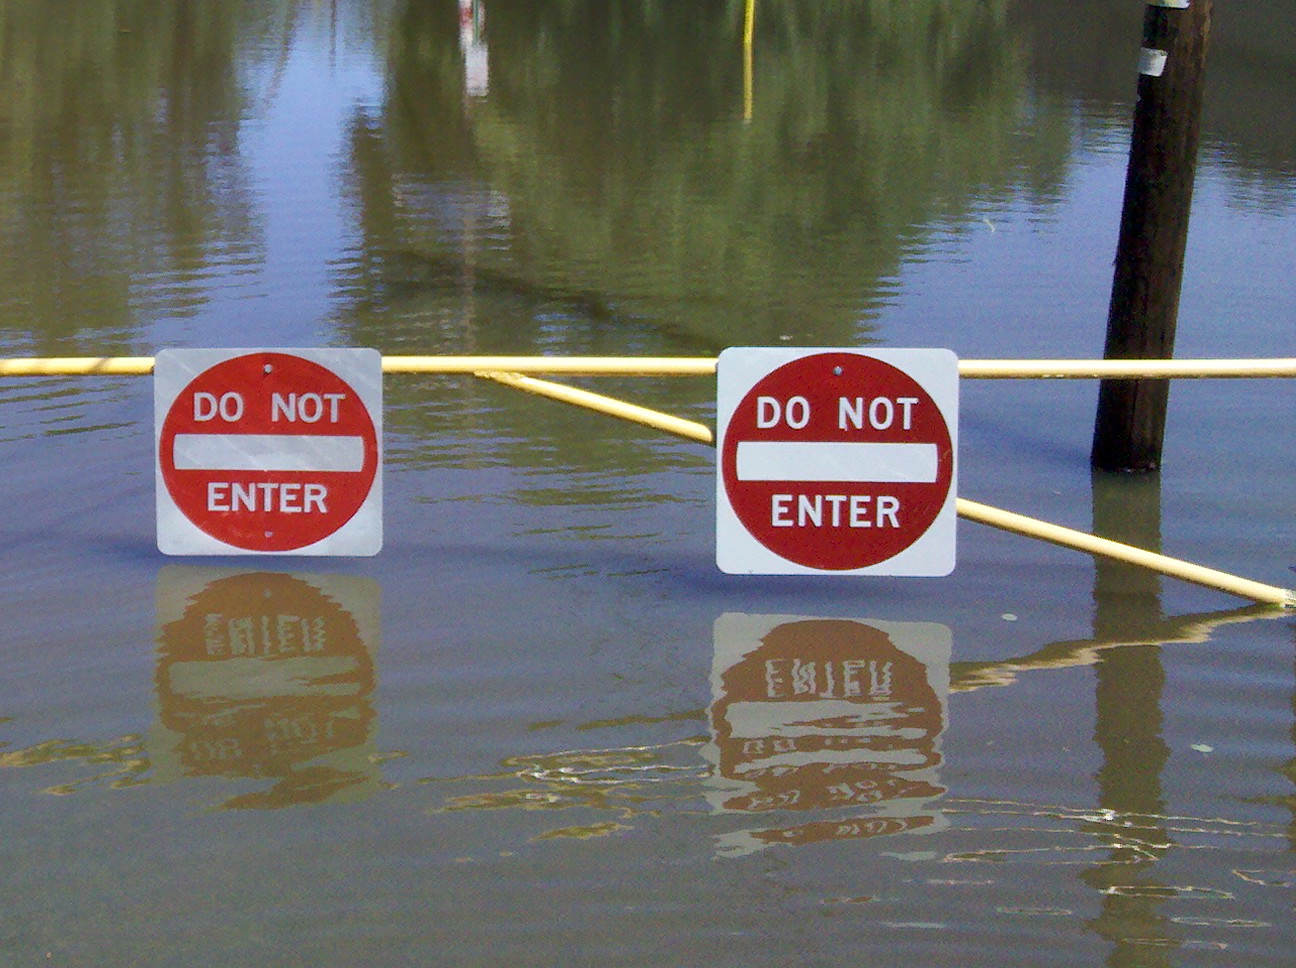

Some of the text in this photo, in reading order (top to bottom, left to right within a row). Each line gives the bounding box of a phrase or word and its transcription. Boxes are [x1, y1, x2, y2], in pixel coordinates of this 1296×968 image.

[193, 392, 346, 423] DO NOT
[757, 396, 919, 431] DO NOT
[207, 482, 328, 513] ENTER
[771, 494, 900, 528] ENTER
